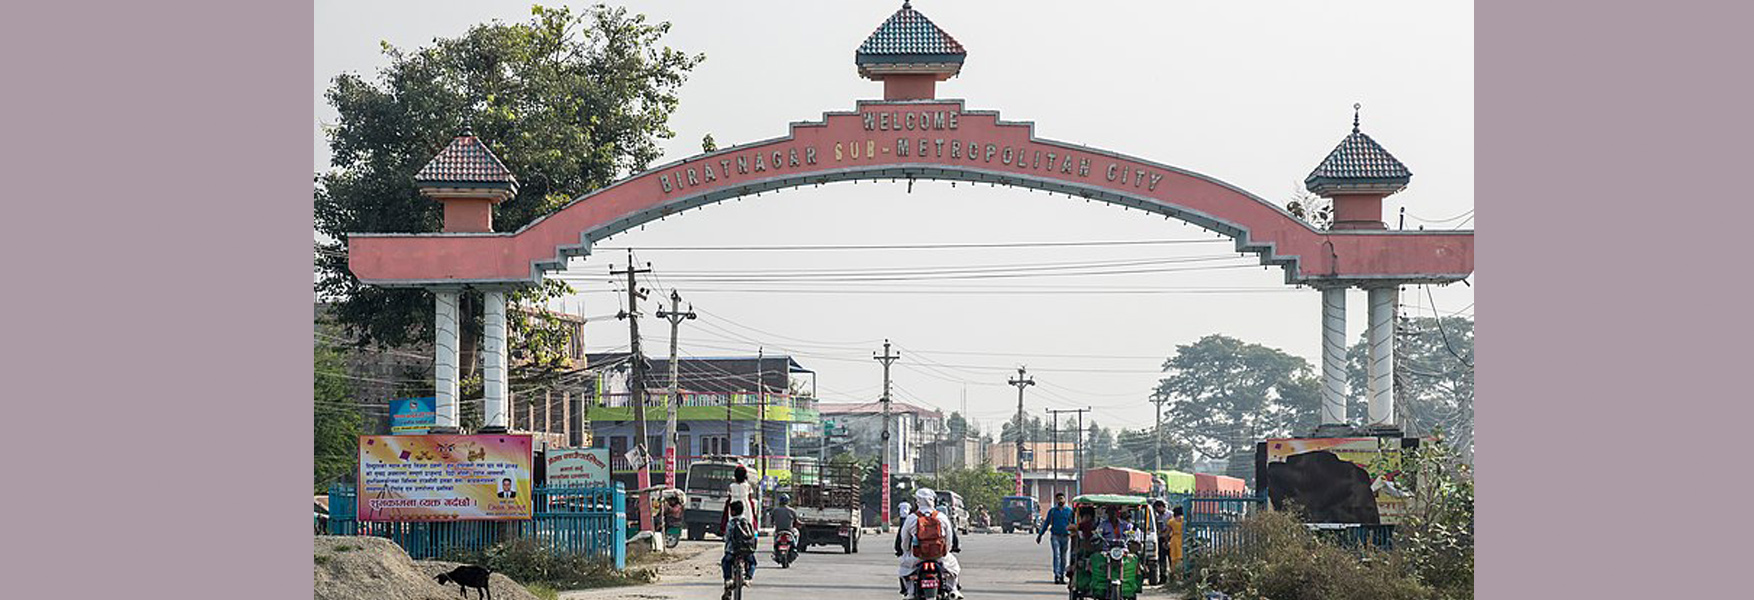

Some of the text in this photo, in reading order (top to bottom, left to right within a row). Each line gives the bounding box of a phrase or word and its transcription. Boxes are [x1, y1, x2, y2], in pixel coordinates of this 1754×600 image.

[863, 110, 960, 131] WELCOME
[659, 147, 818, 193] BIRATNAGAR
[1106, 163, 1163, 192] CITY
